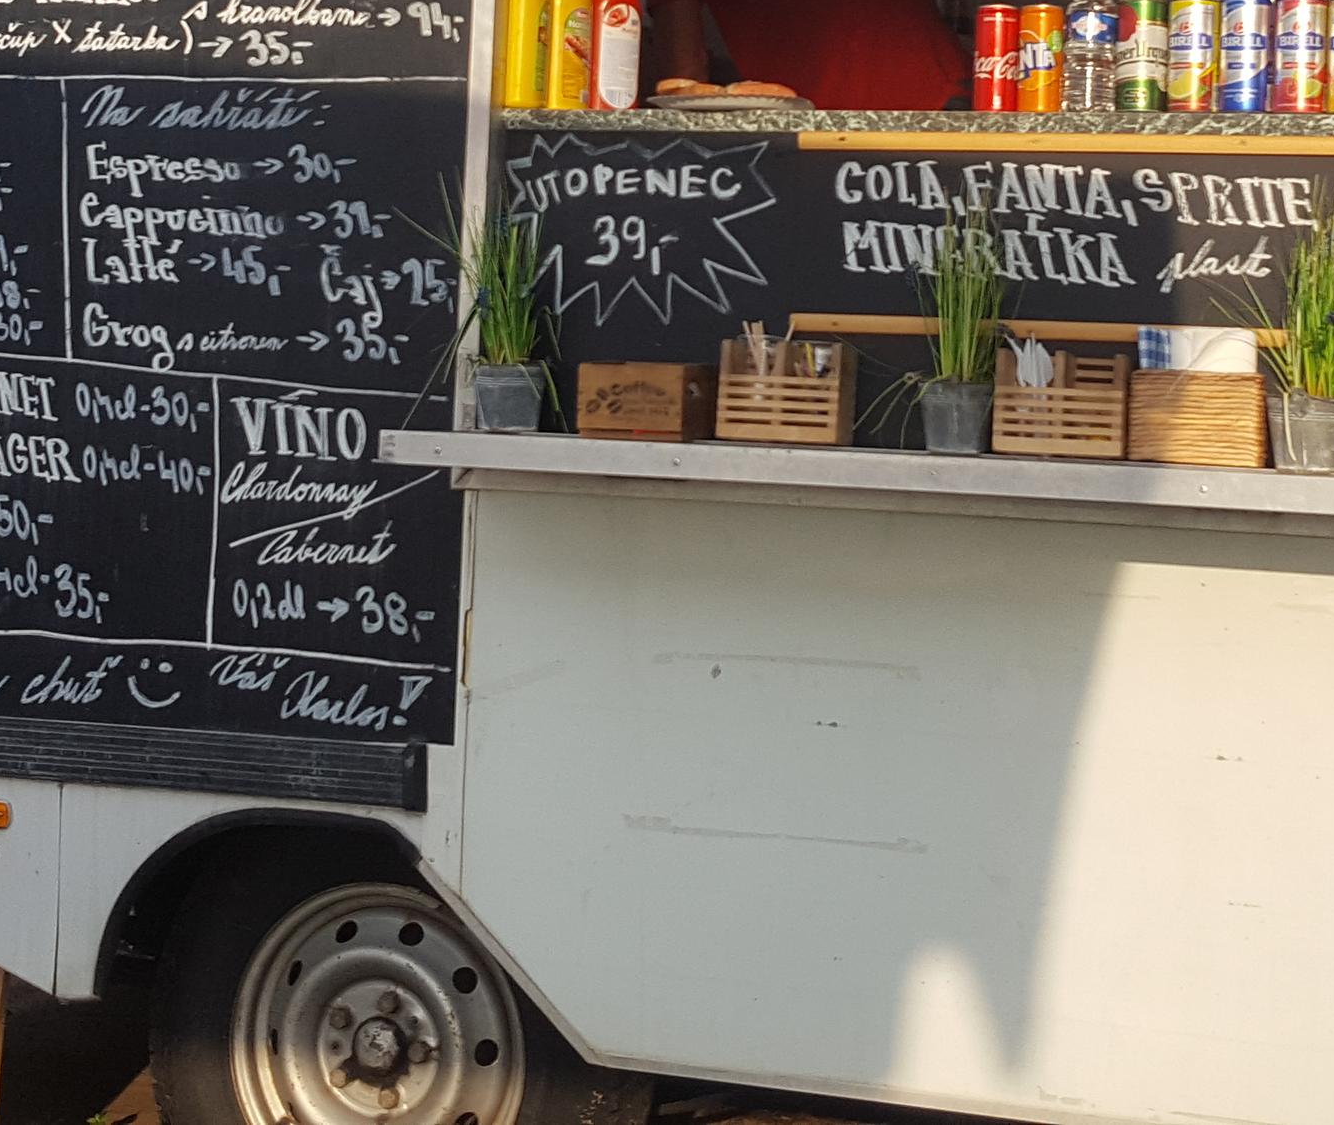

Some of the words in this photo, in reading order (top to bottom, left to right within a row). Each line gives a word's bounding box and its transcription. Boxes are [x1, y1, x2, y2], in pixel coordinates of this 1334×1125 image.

[181, 0, 209, 20] s
[1019, 41, 1057, 72] NTA
[81, 84, 146, 128] Na
[86, 141, 242, 198] Espresso
[526, 163, 742, 213] UTOPENEC
[1133, 168, 1317, 231] SPRITE
[584, 214, 680, 276] 39,-
[319, 243, 384, 329] Čaj
[82, 301, 175, 373] Grog
[175, 332, 195, 352] s
[229, 389, 369, 462] VÍNO
[219, 460, 378, 522] Chardonnay
[256, 520, 397, 565] Cabernet
